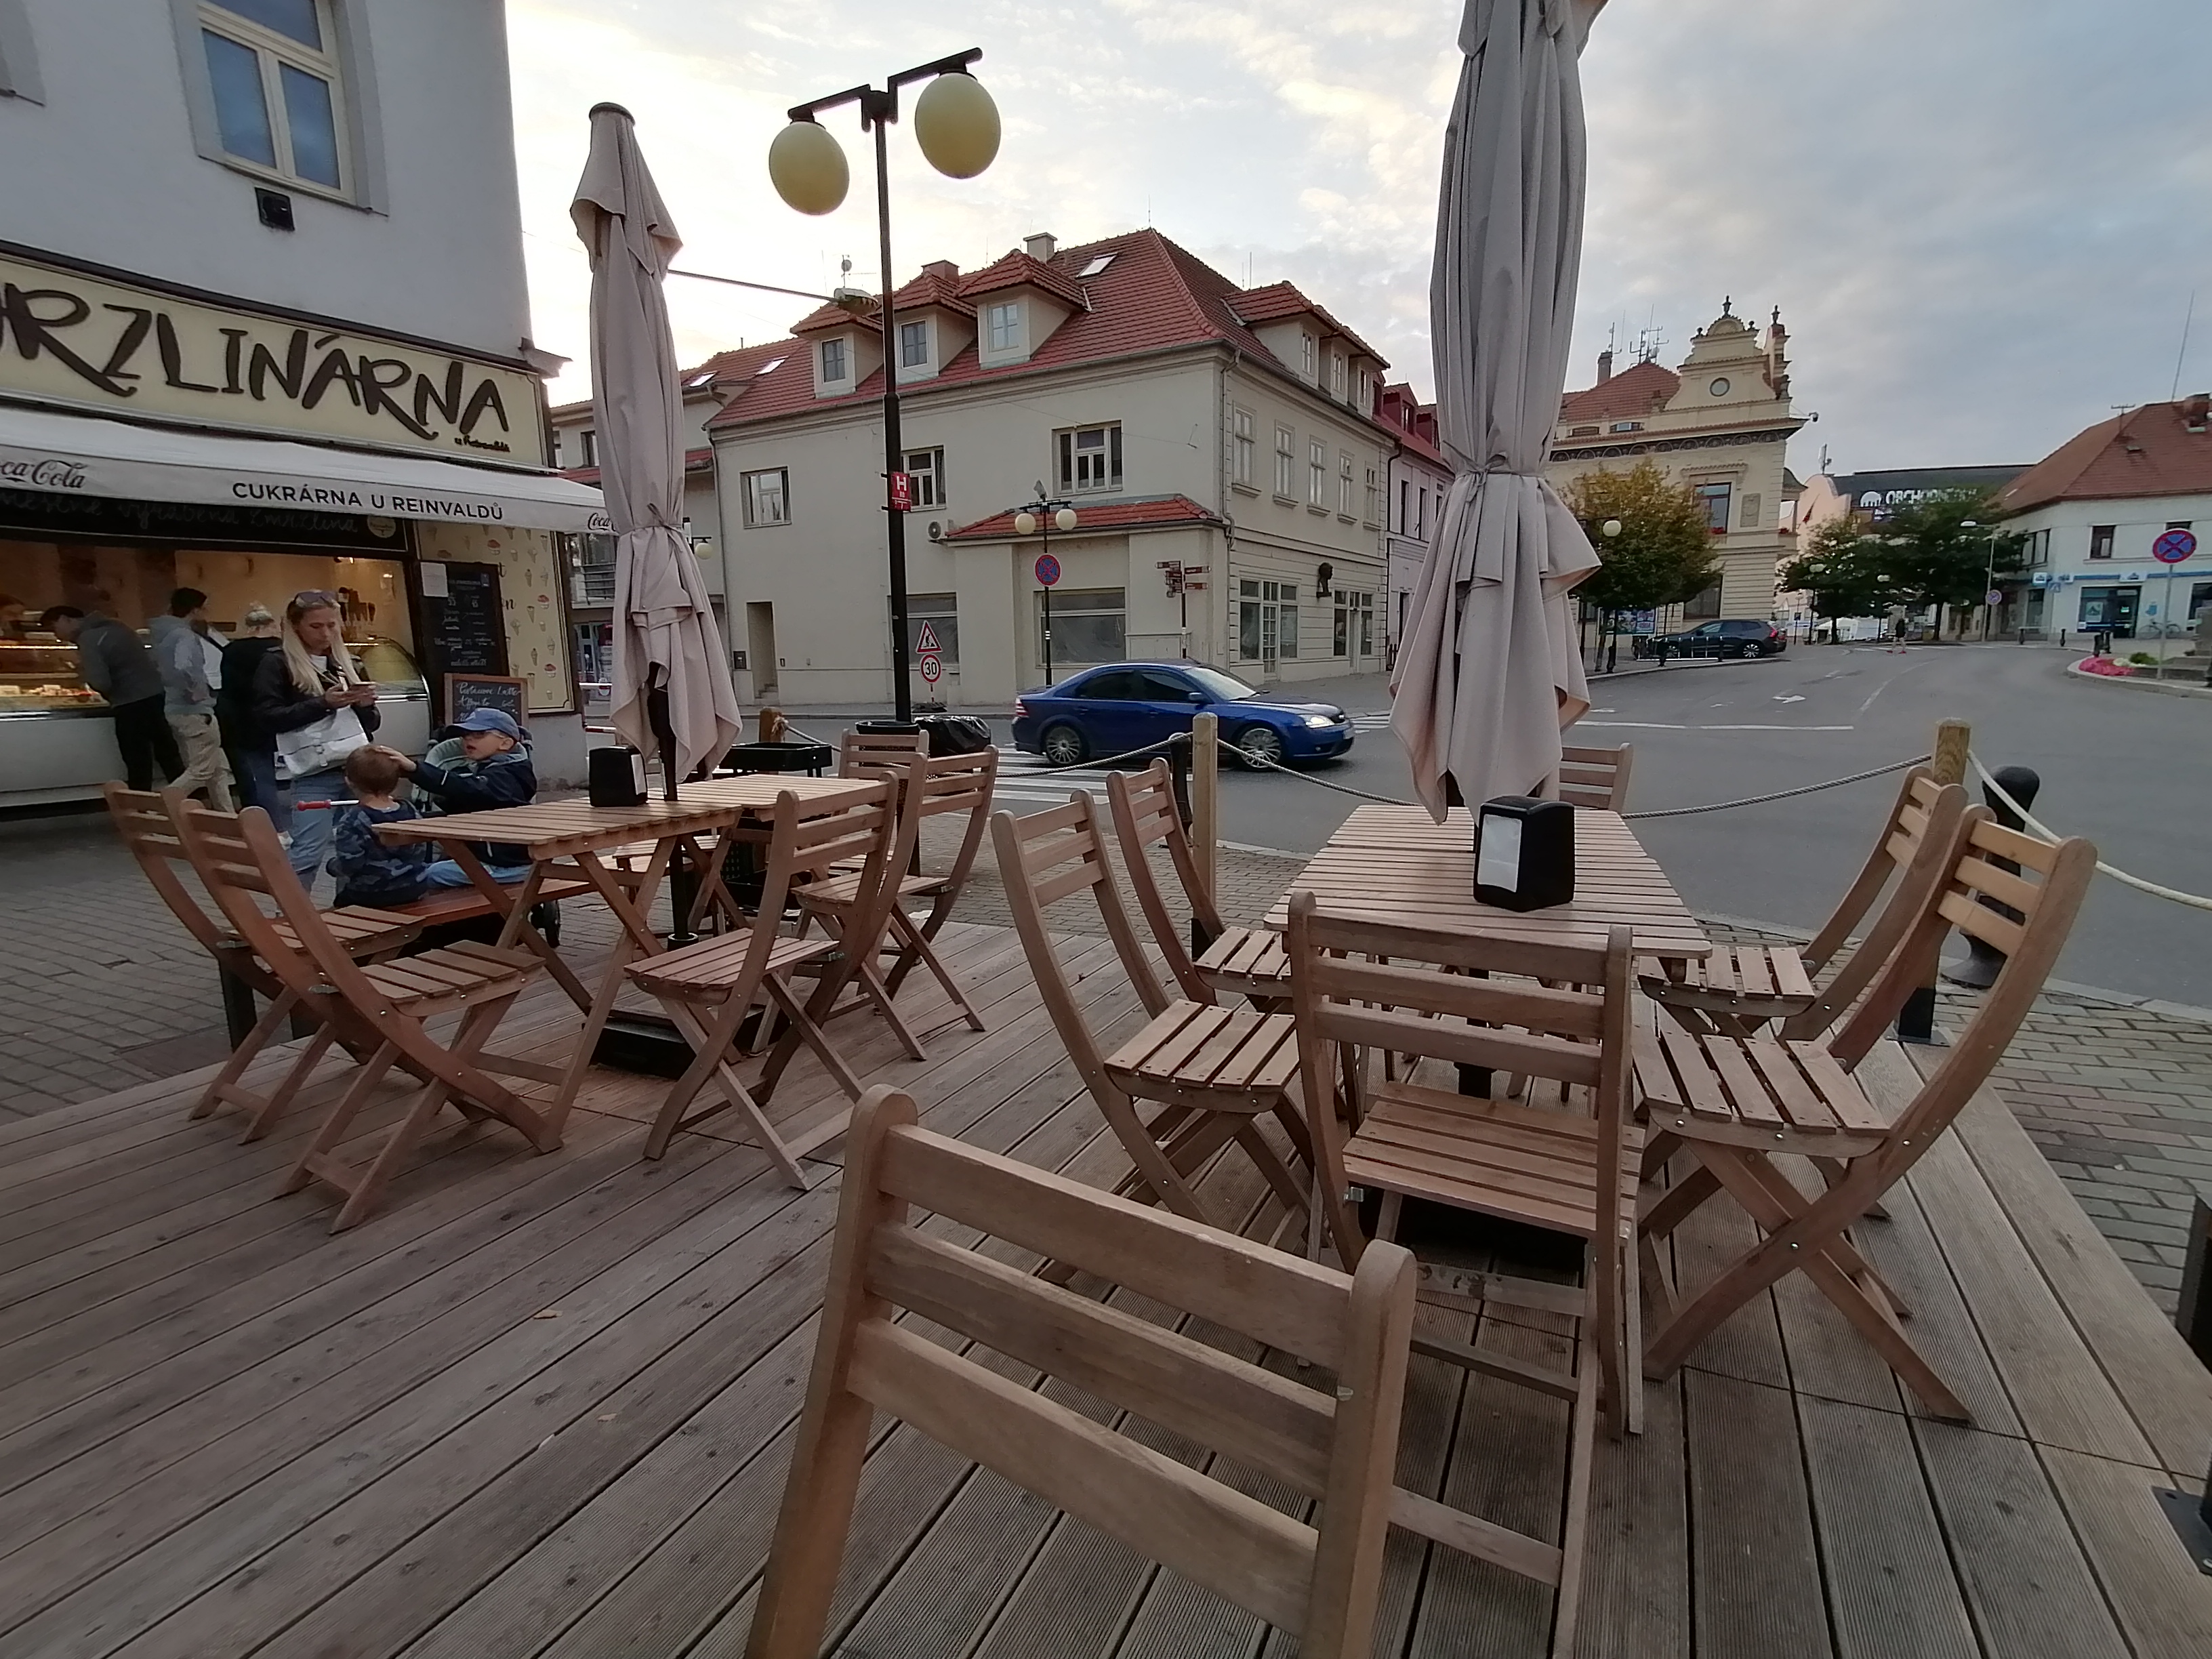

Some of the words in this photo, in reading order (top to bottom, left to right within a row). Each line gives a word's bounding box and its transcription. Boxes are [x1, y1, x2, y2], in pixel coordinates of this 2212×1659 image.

[0, 283, 509, 441] RZLINÁRNA
[0, 459, 88, 489] ca-Cola
[896, 476, 907, 491] H
[232, 483, 363, 507] CUKRÁRNA
[371, 494, 385, 509] U
[392, 496, 503, 520] REINVALDŮ
[588, 512, 617, 532] Coca
[924, 661, 937, 676] 30
